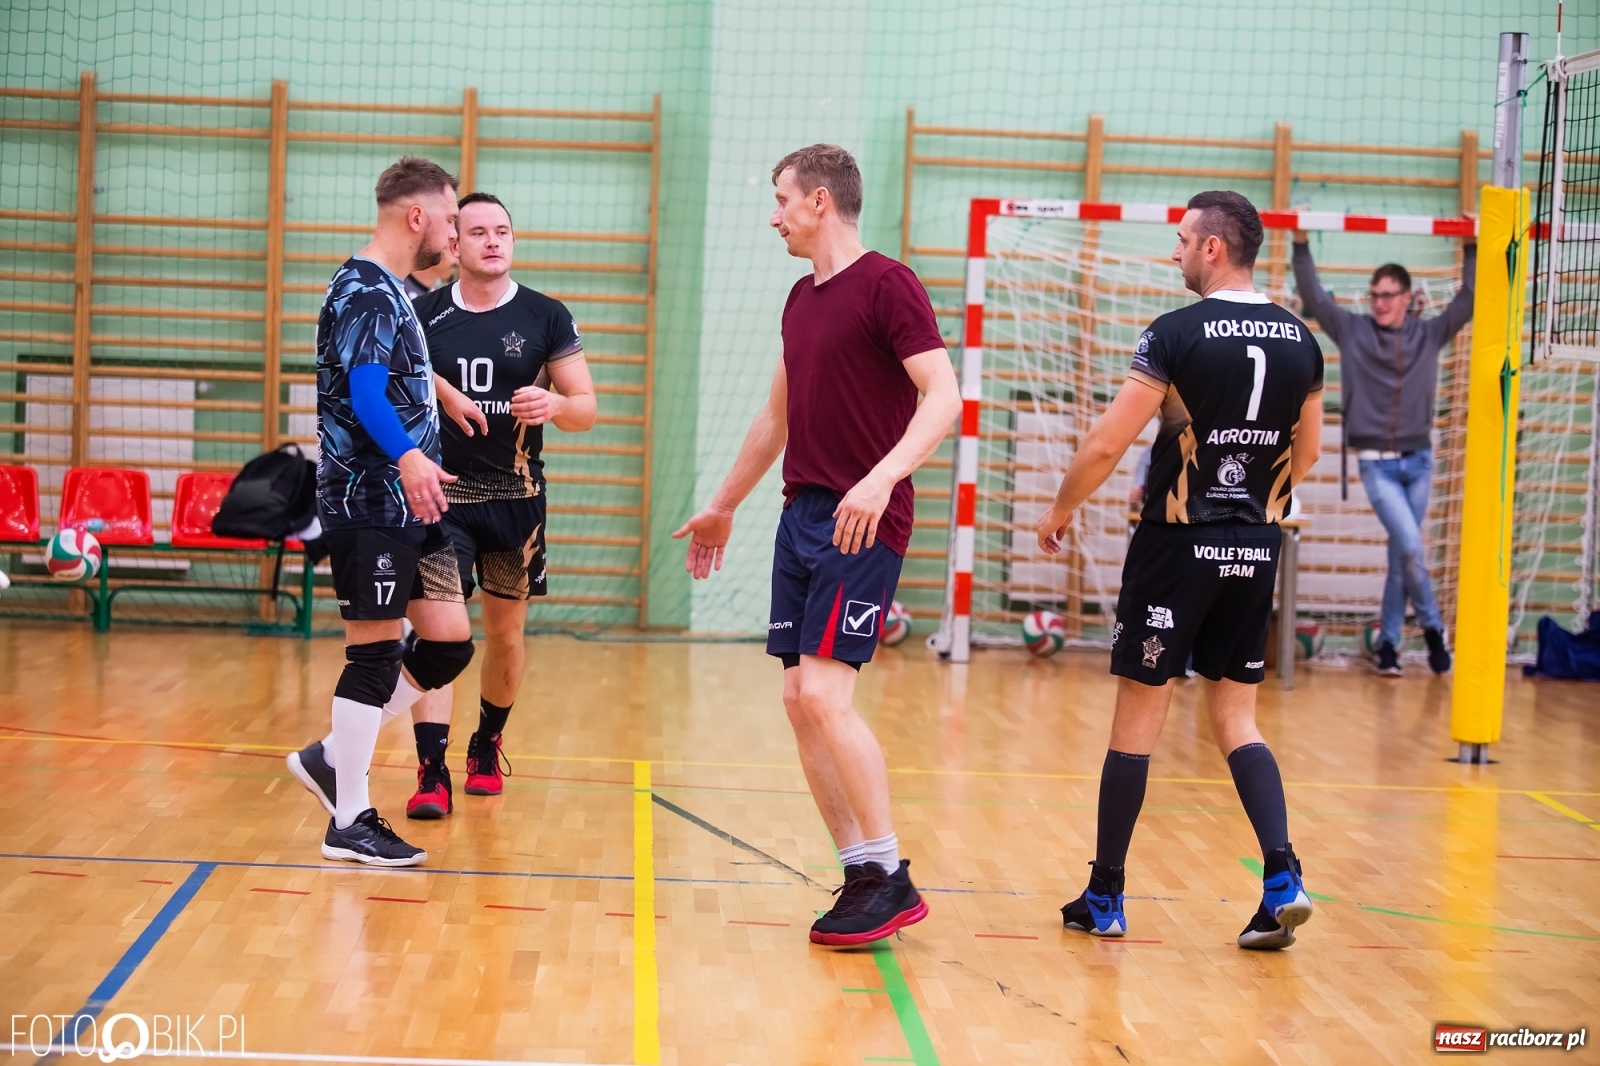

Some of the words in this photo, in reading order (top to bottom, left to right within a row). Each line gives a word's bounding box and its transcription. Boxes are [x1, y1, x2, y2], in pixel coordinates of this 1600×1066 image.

[1203, 319, 1302, 342] KOŁODZIEJ
[456, 357, 494, 393] 10
[1245, 345, 1267, 421] 1
[477, 400, 511, 415] OTIM
[1206, 428, 1280, 445] AGROTIM
[1193, 545, 1272, 561] VOLLEYBALL
[1218, 564, 1255, 578] TEAM
[374, 581, 396, 605] 17
